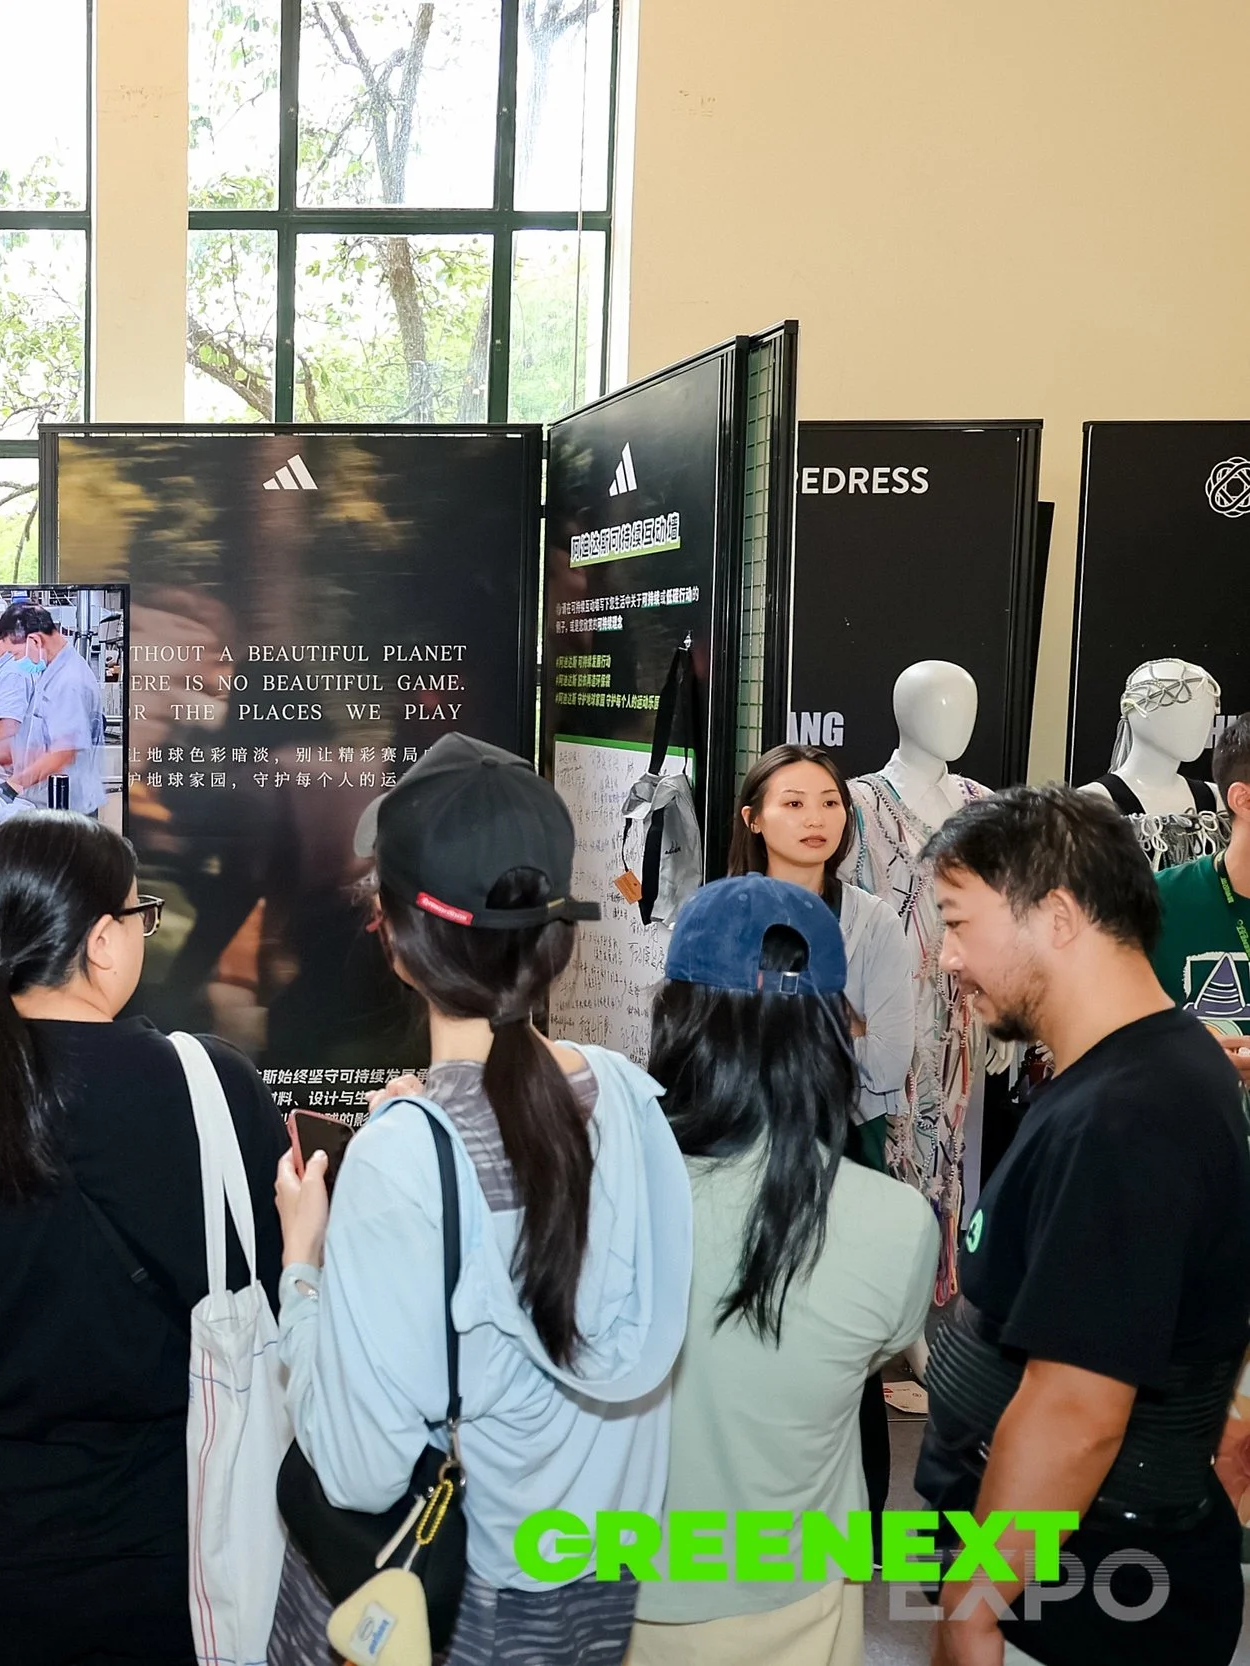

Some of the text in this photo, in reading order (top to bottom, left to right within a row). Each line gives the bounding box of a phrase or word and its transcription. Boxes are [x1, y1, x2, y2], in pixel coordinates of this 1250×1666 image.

[796, 466, 929, 494] EDRESS
[570, 512, 680, 562] 阿迪达斯可持续互动墙
[130, 646, 467, 662] THOUT A BEAUTIFUL PLANET
[131, 675, 465, 691] ERE IS NO BEAUTIFUL GAME.
[129, 704, 462, 721] R THE PLACES WE PLAY
[129, 746, 433, 764] 让地球色彩暗淡，别让精彩赛局
[129, 772, 406, 789] 护地球家园，守护每个人的运
[256, 1069, 430, 1084] 斯始终坚守可持续发承
